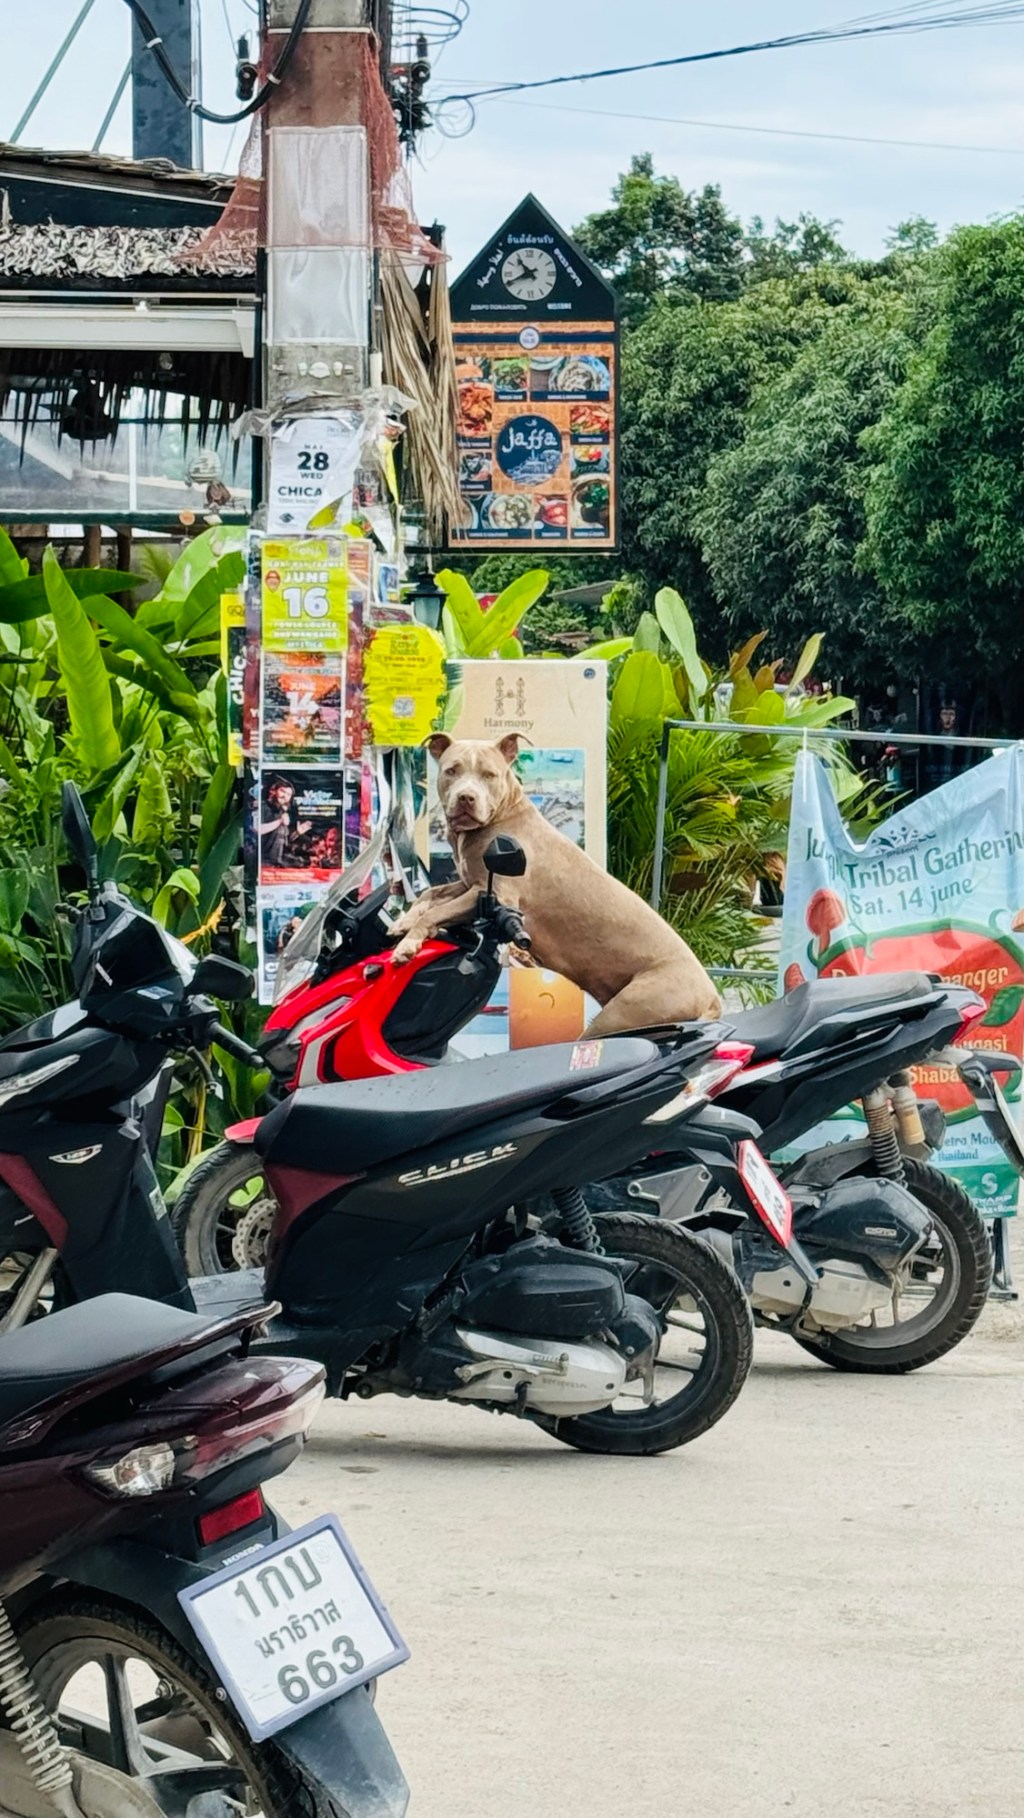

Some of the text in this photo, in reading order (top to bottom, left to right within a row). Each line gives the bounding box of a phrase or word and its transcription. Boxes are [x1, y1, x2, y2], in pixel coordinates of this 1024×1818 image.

[502, 427, 558, 452] Jaffa
[297, 451, 330, 471] 28
[300, 472, 324, 480] WED
[284, 571, 329, 584] JUNE
[282, 586, 330, 619] 16
[484, 717, 534, 731] Harmony
[844, 855, 919, 890] Tribal
[923, 829, 1024, 876] Gatherin
[849, 876, 974, 916] Sat. 14 june
[970, 1132, 998, 1146] Mou
[397, 1142, 518, 1184] CLICK
[221, 1542, 265, 1567] HONDA
[233, 1547, 323, 1618] 1กบ
[254, 1597, 343, 1659] นราธิวาส
[276, 1634, 365, 1705] 663
